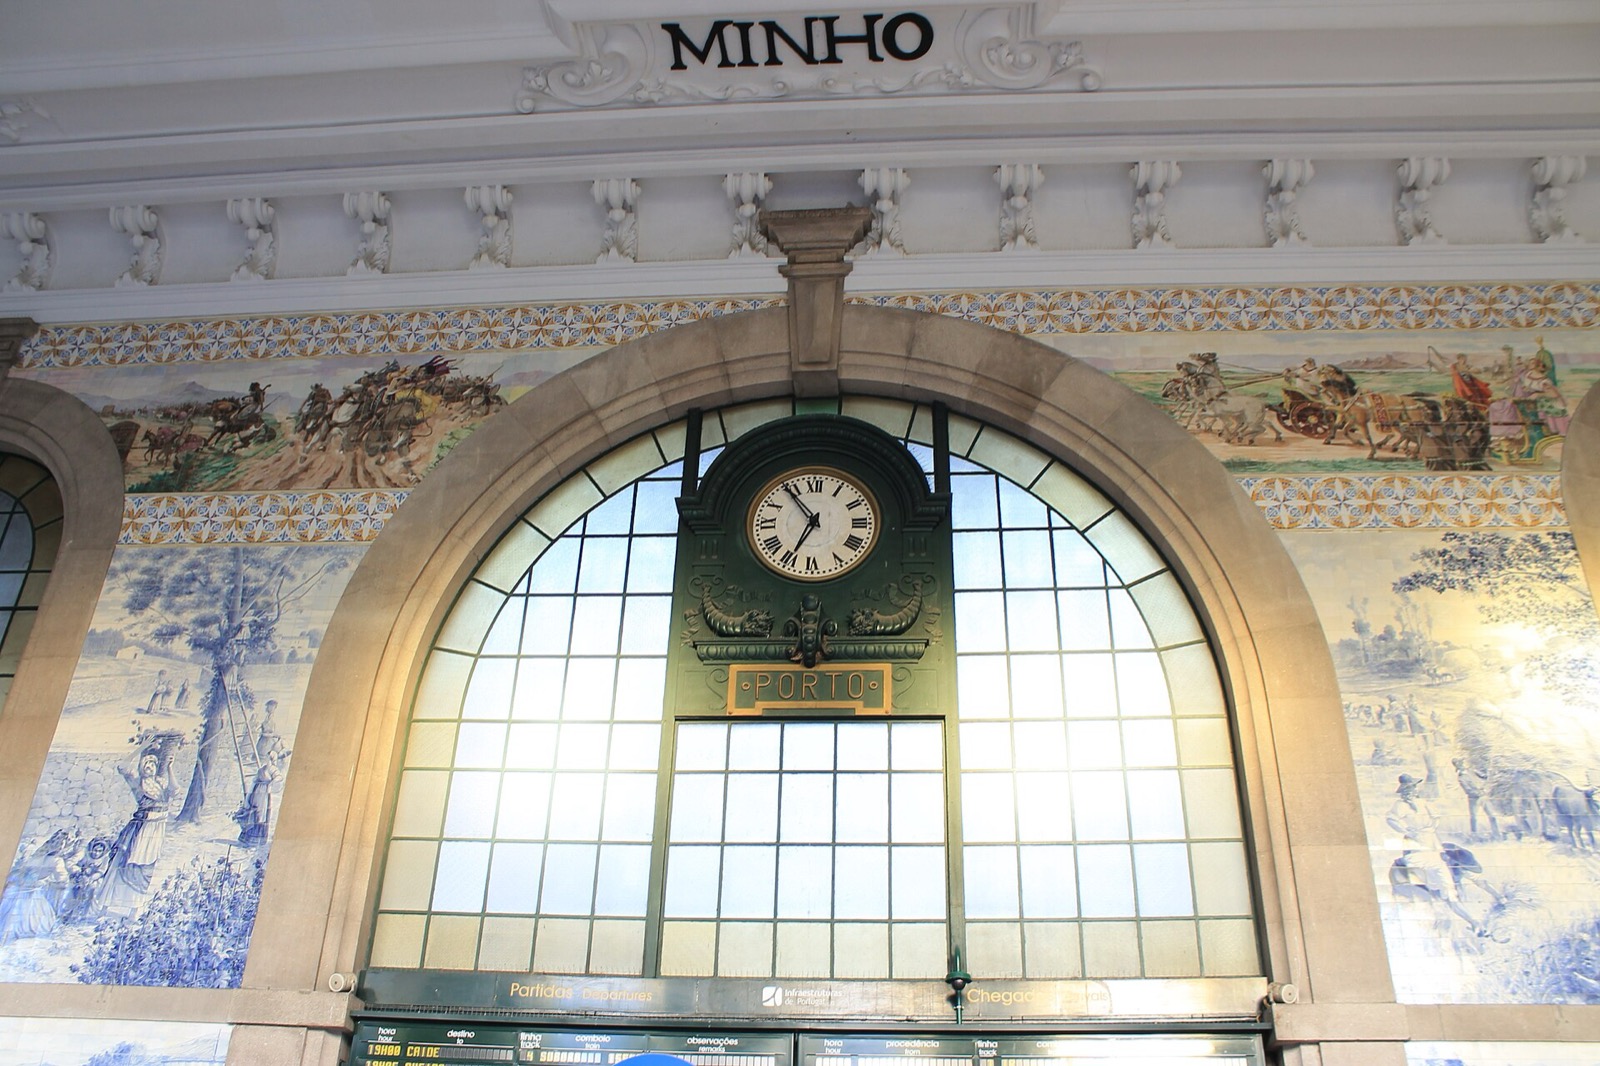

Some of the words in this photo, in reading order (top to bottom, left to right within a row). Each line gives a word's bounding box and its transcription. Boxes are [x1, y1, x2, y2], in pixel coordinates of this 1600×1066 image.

[661, 12, 934, 70] MINHO
[755, 672, 864, 699] PORTO
[510, 982, 573, 999] Partidas
[582, 988, 653, 1001] Departures
[785, 989, 842, 997] Infraestruturas
[377, 1027, 397, 1036] hora
[447, 1029, 475, 1038] destino
[520, 1032, 541, 1041] linha
[686, 1036, 738, 1046] observações
[824, 1039, 843, 1047] hora
[885, 1039, 939, 1049] procedência
[406, 1046, 440, 1058] CAIDE
